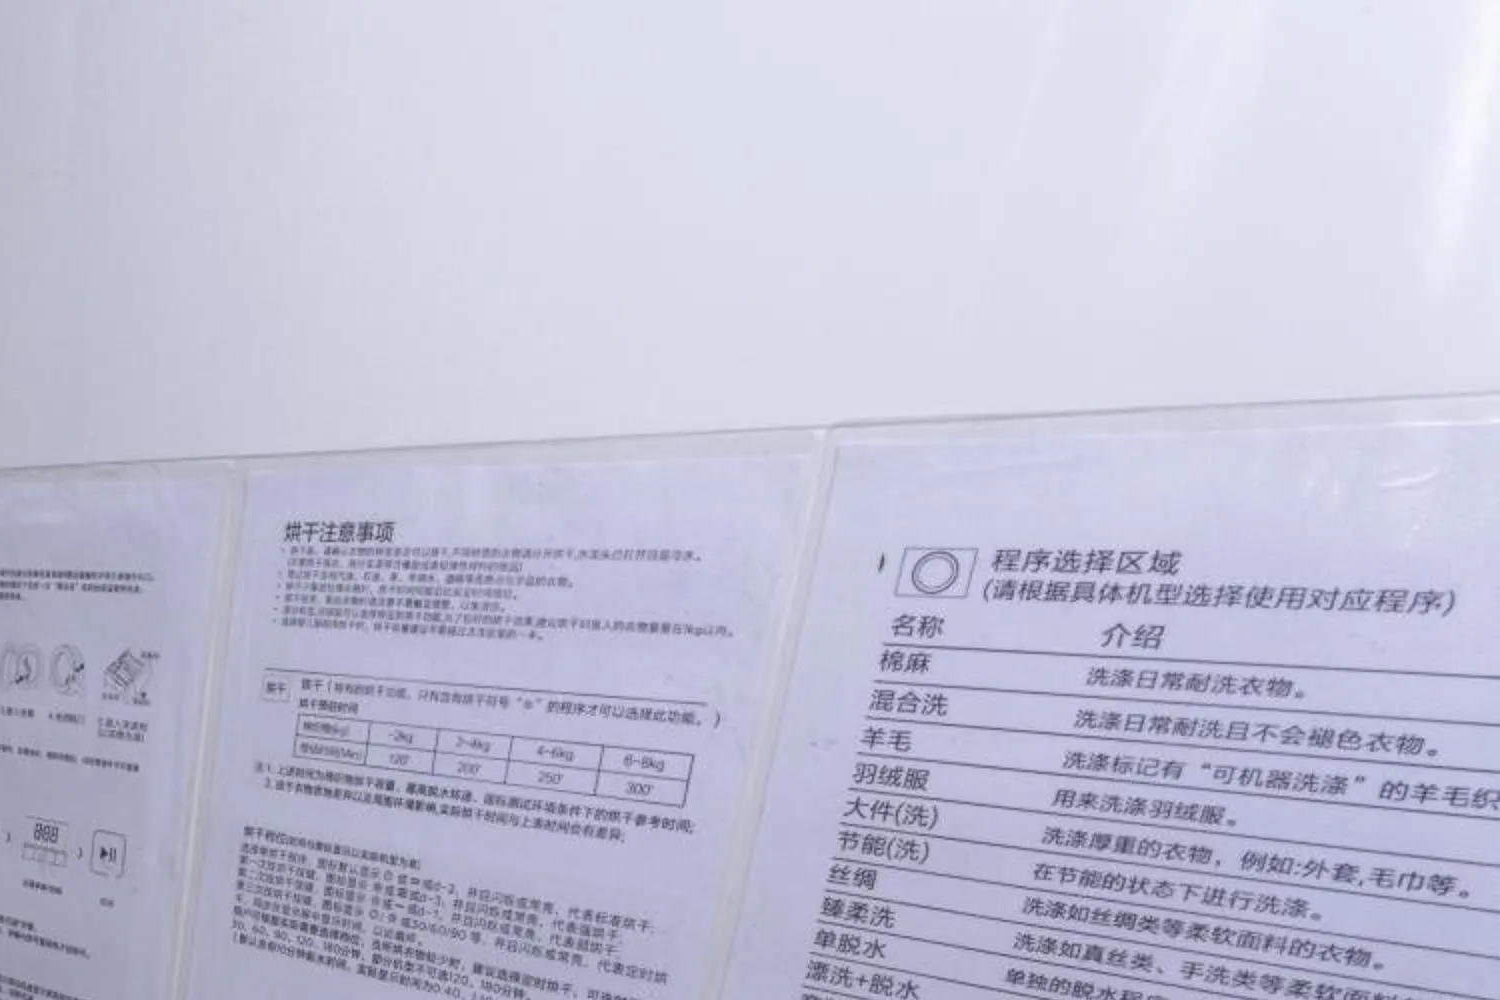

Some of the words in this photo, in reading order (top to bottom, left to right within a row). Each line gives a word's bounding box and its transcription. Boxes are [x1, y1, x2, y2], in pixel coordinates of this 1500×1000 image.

[283, 520, 396, 544] 烘干注意事项
[991, 549, 1182, 575] 程序选择区域
[983, 579, 1457, 617] (请根据具体机型选择使用对应程序)
[891, 614, 945, 639] 名称
[1100, 623, 1166, 650] 介绍
[880, 649, 932, 673] 棉麻
[1085, 666, 1307, 700] 洗涤日常耐洗衣物。
[860, 727, 912, 753] 羊毛
[868, 689, 948, 716] 混合洗
[1073, 709, 1441, 759] 洗涤日常耐洗且不会褪色衣物。
[844, 796, 940, 830] 大件(洗)
[851, 763, 930, 792] 羽绒服
[1052, 789, 1238, 829] 用来洗涤羽绒服。
[836, 829, 931, 864] 节能(洗)
[1032, 862, 1324, 922] 在节能的状态下进行洗涤。
[819, 894, 896, 929] 臻柔洗
[826, 864, 877, 892] 丝绸
[1021, 895, 1386, 971] 洗涤如丝绸类等柔软面料的衣物。
[813, 927, 887, 960] 单脱水
